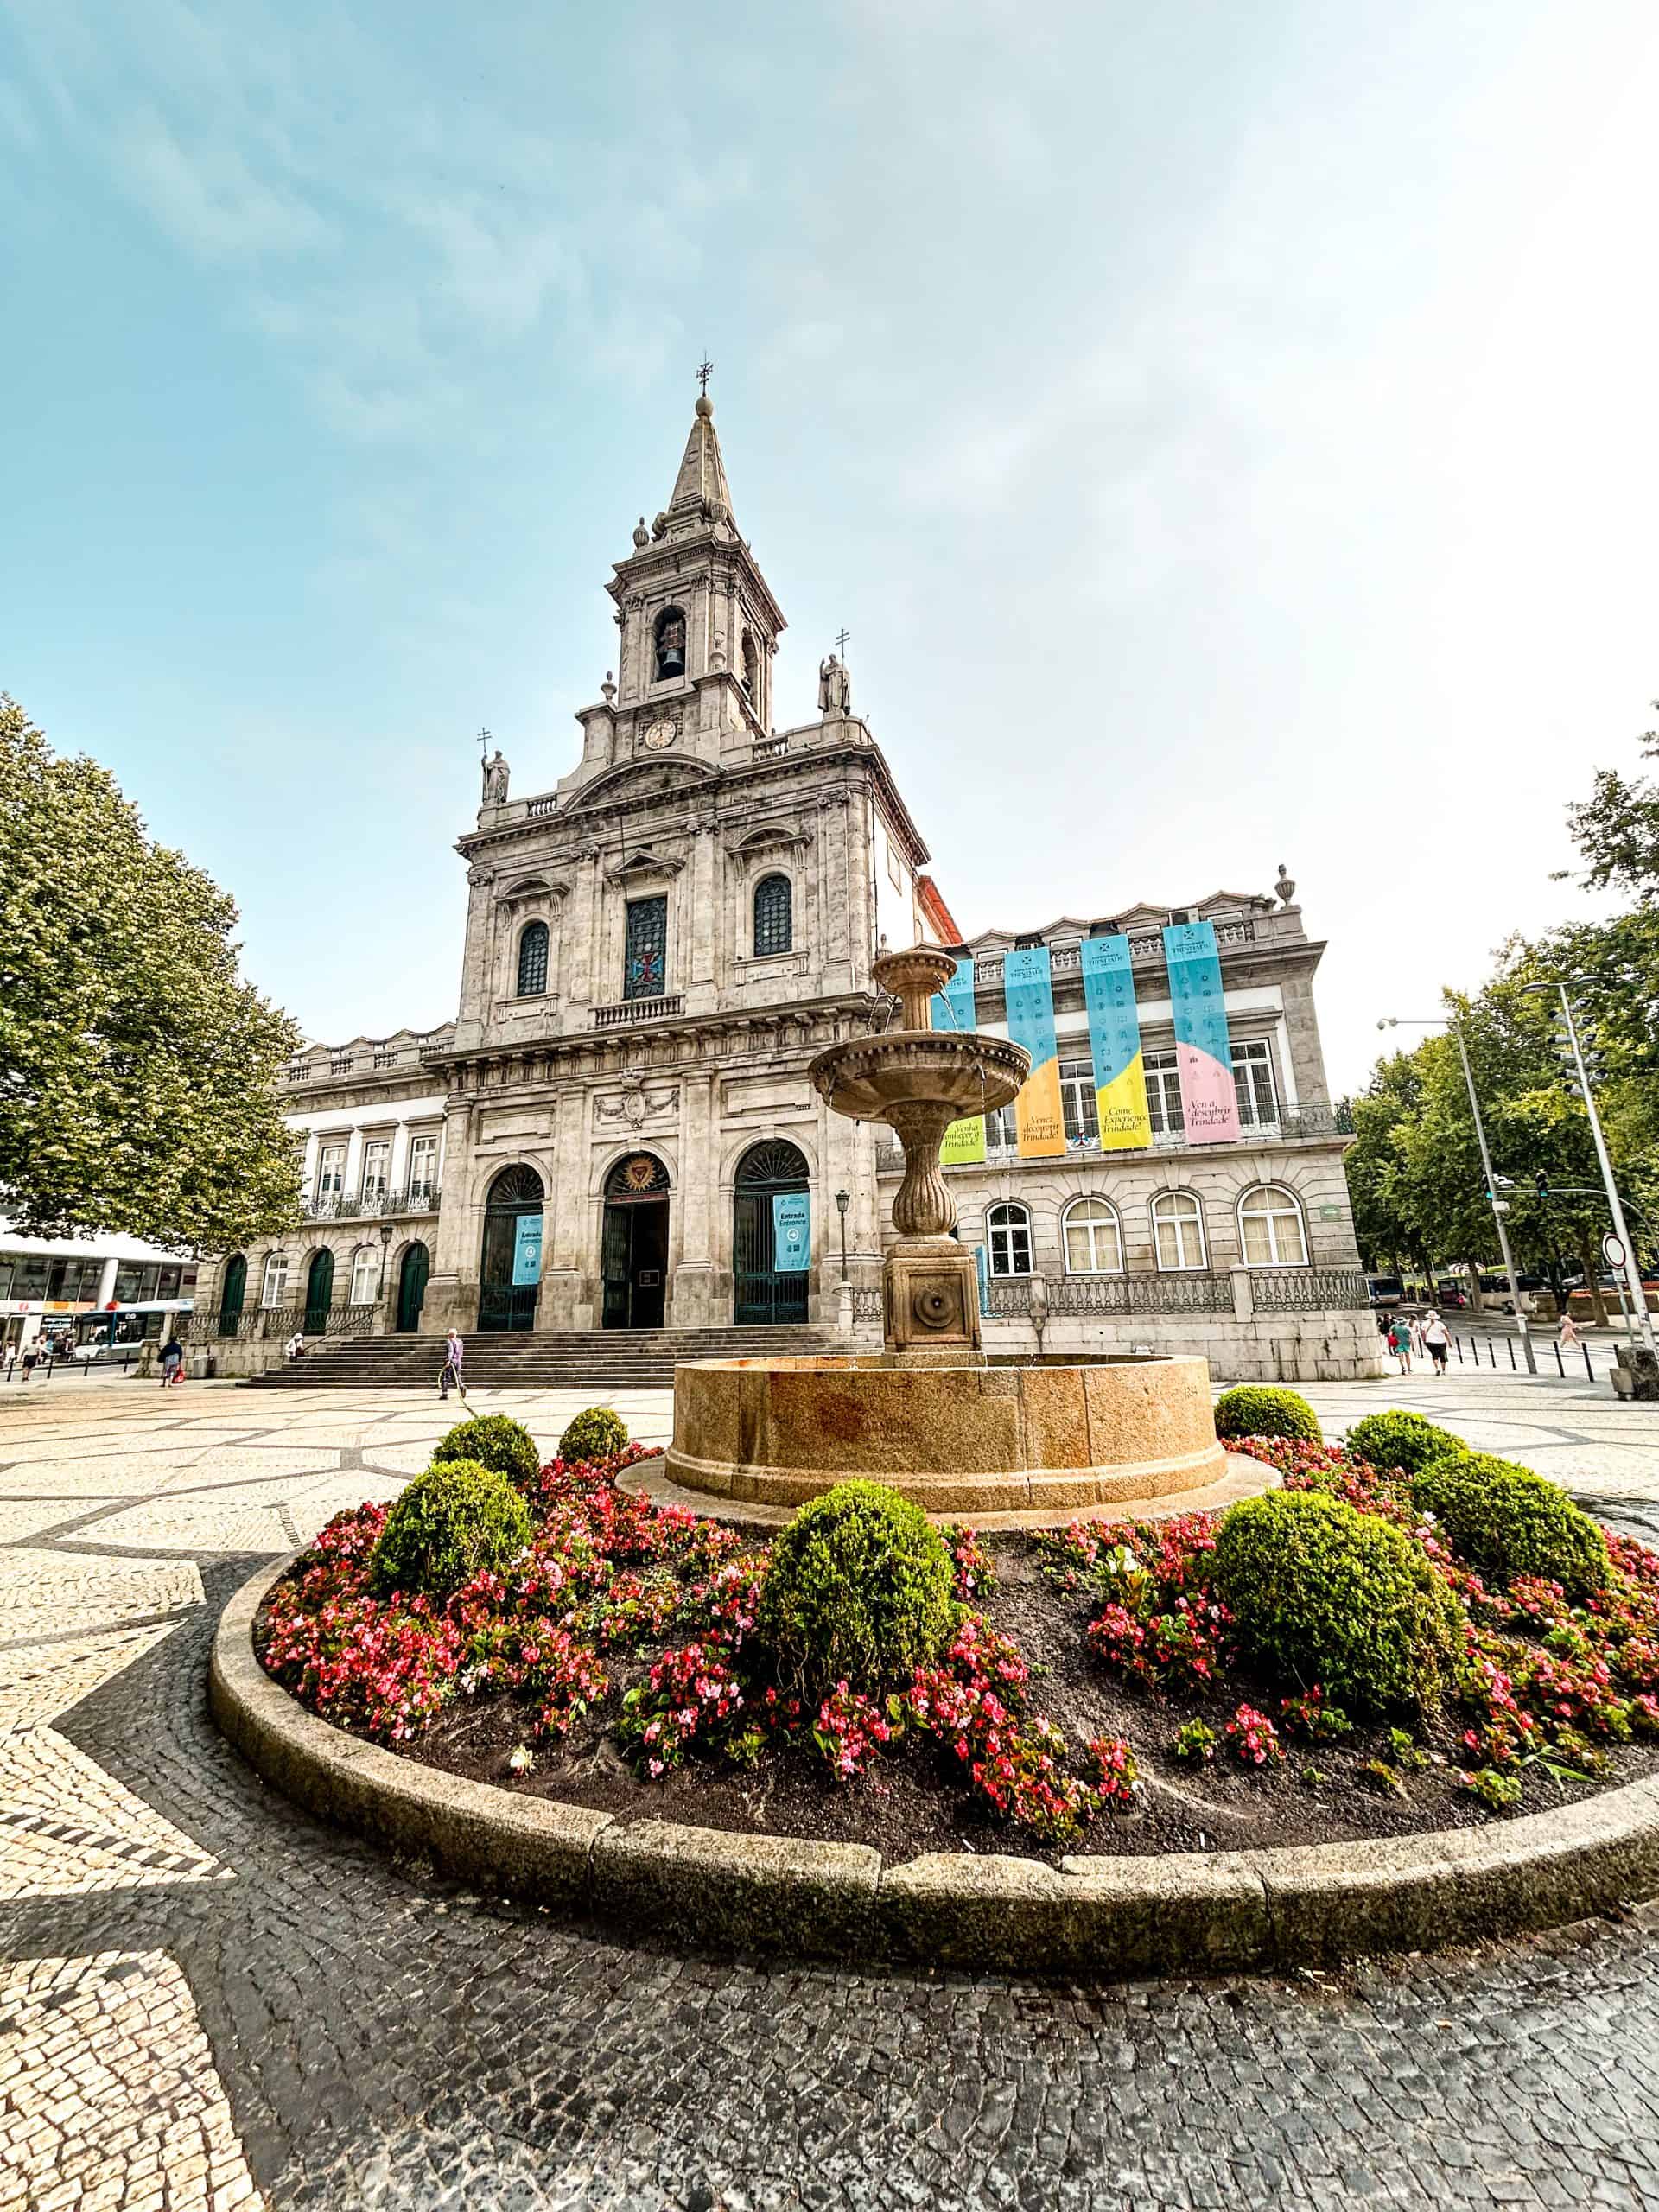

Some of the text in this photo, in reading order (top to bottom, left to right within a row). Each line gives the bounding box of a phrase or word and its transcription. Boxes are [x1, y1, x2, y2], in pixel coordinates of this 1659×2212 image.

[1109, 1106, 1133, 1115] Come
[1191, 1106, 1231, 1117] descubrir
[1030, 1116, 1053, 1124] Venez
[1104, 1114, 1148, 1125] Experience
[1188, 1115, 1231, 1127] Trindade!
[1102, 1122, 1141, 1134] Trindade!
[944, 1131, 972, 1141] onhecer
[1021, 1131, 1058, 1141] Trindade!
[780, 1211, 805, 1220] Entrada
